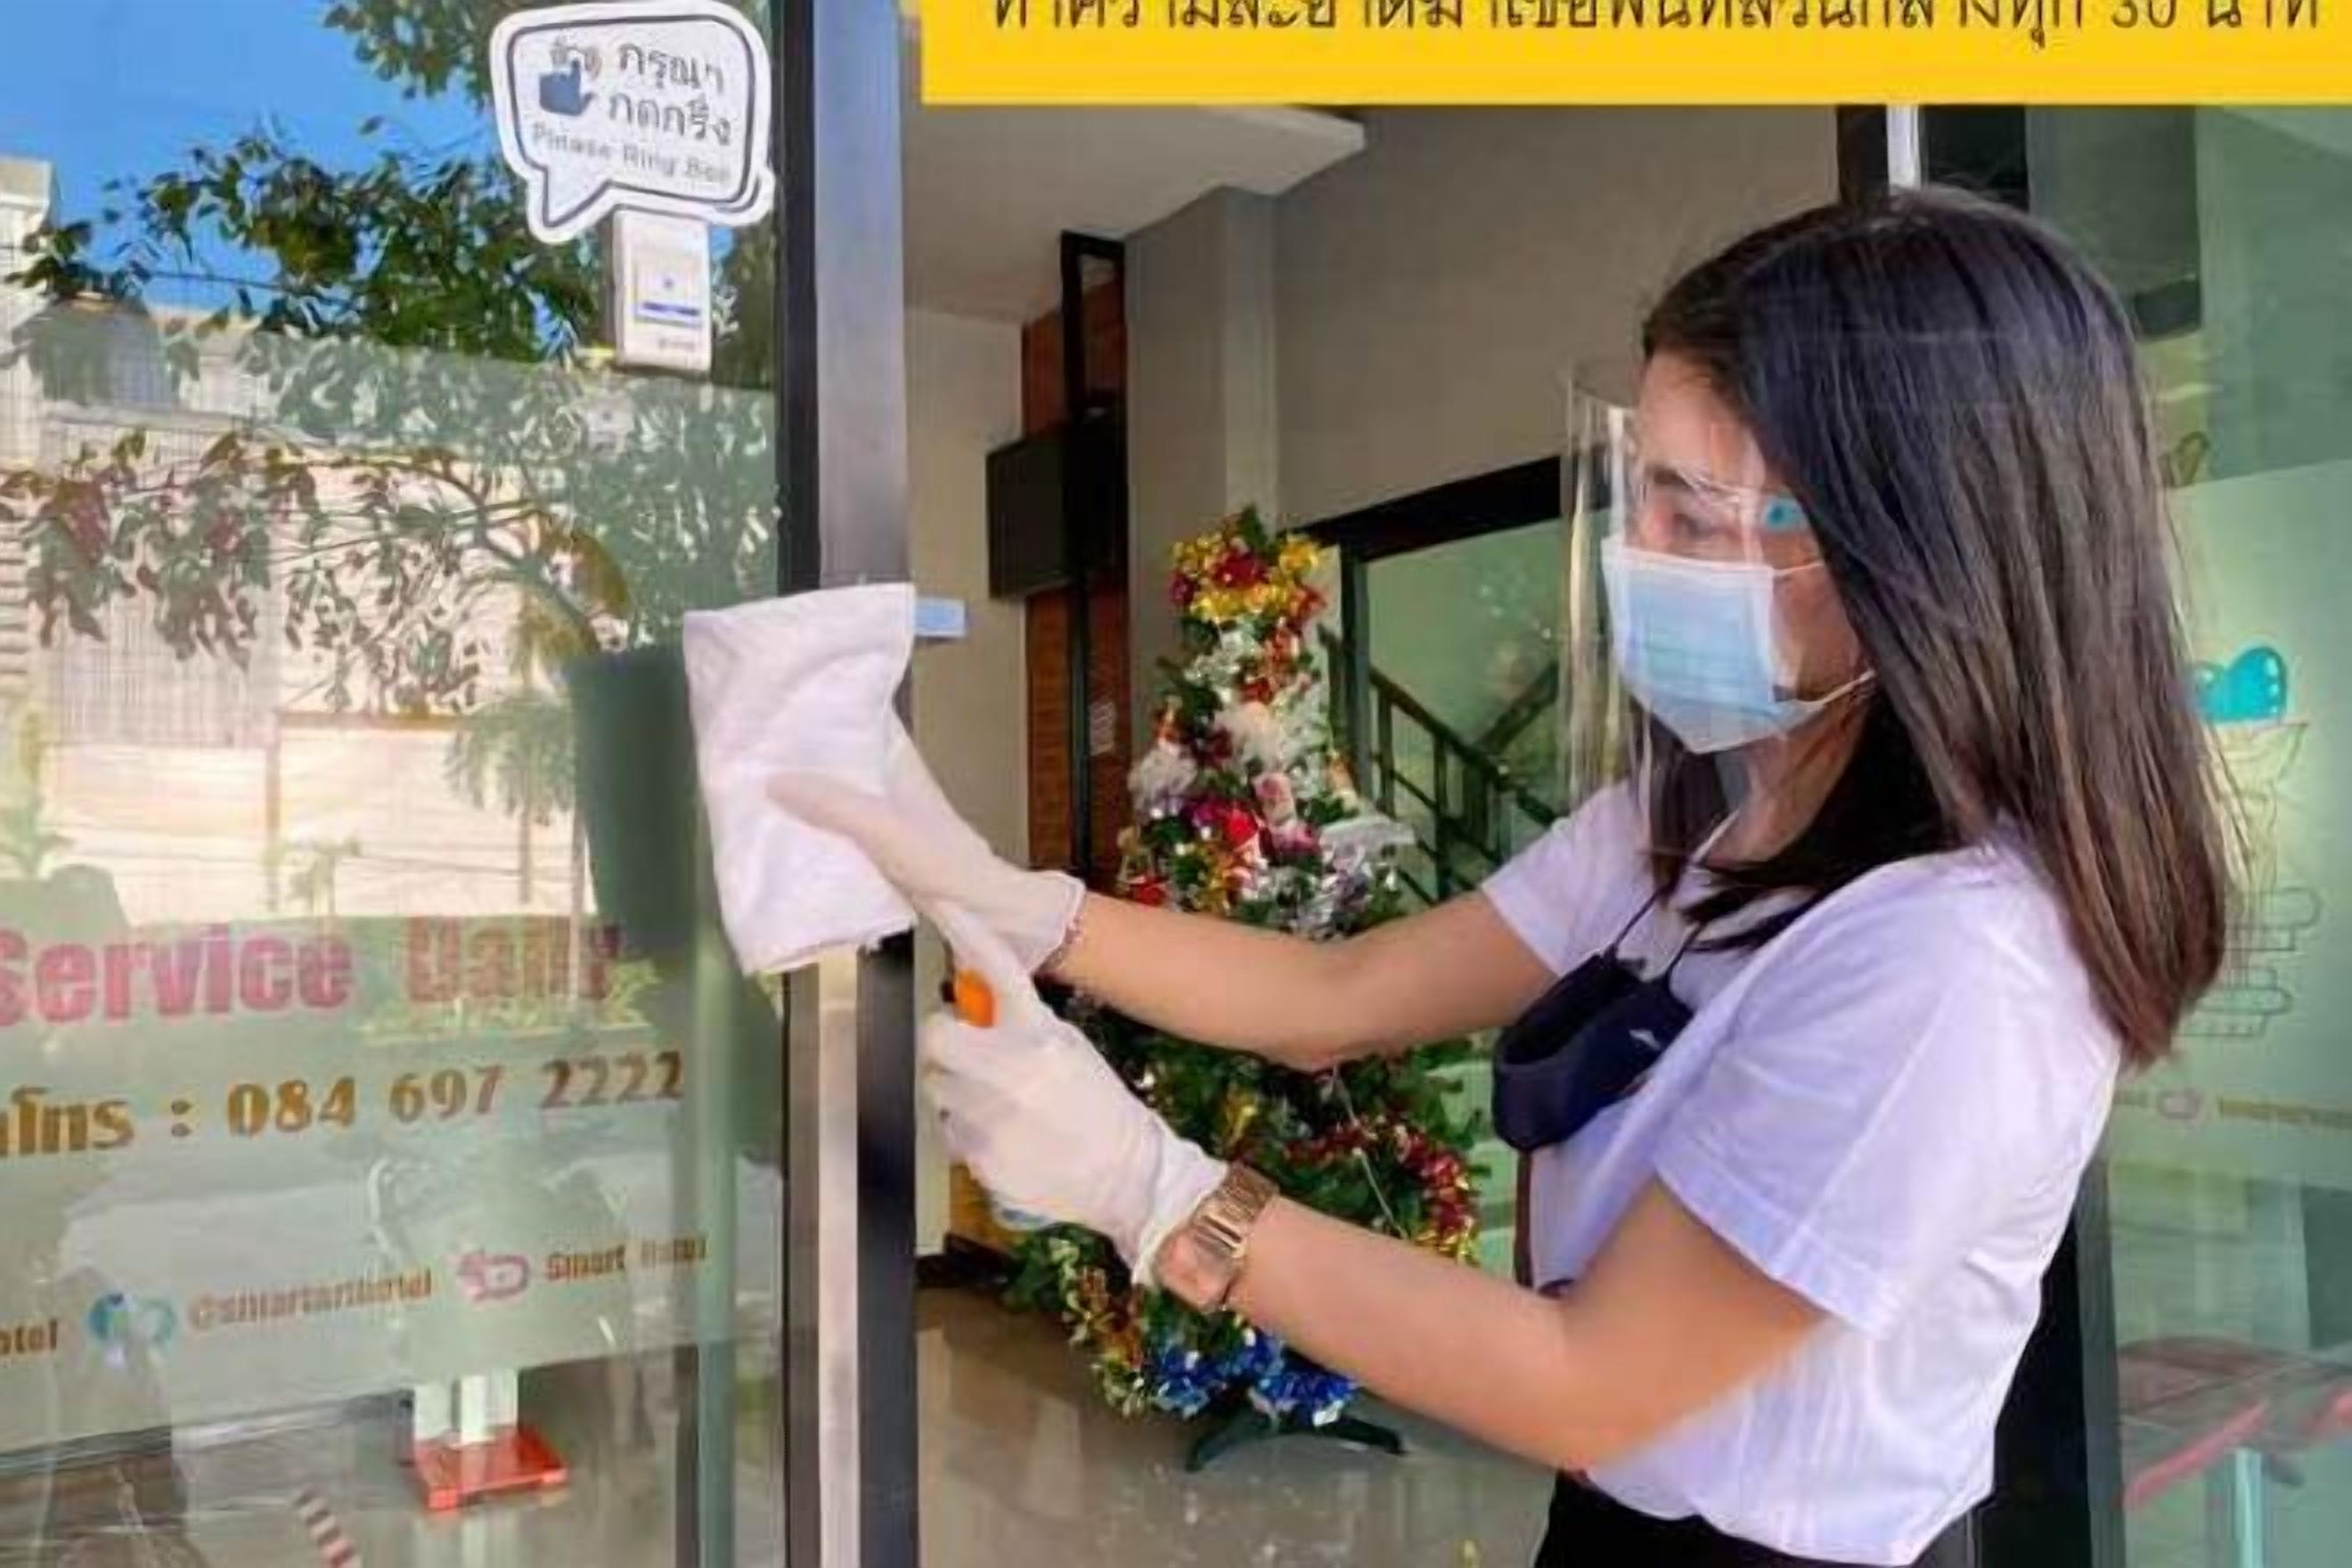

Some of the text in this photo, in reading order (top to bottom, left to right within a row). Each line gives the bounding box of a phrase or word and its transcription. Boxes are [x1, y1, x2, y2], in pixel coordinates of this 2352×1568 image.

[0, 1085, 135, 1156] โทร
[227, 1074, 356, 1139] 084
[389, 1064, 503, 1123] 697
[539, 1049, 685, 1110] 2222
